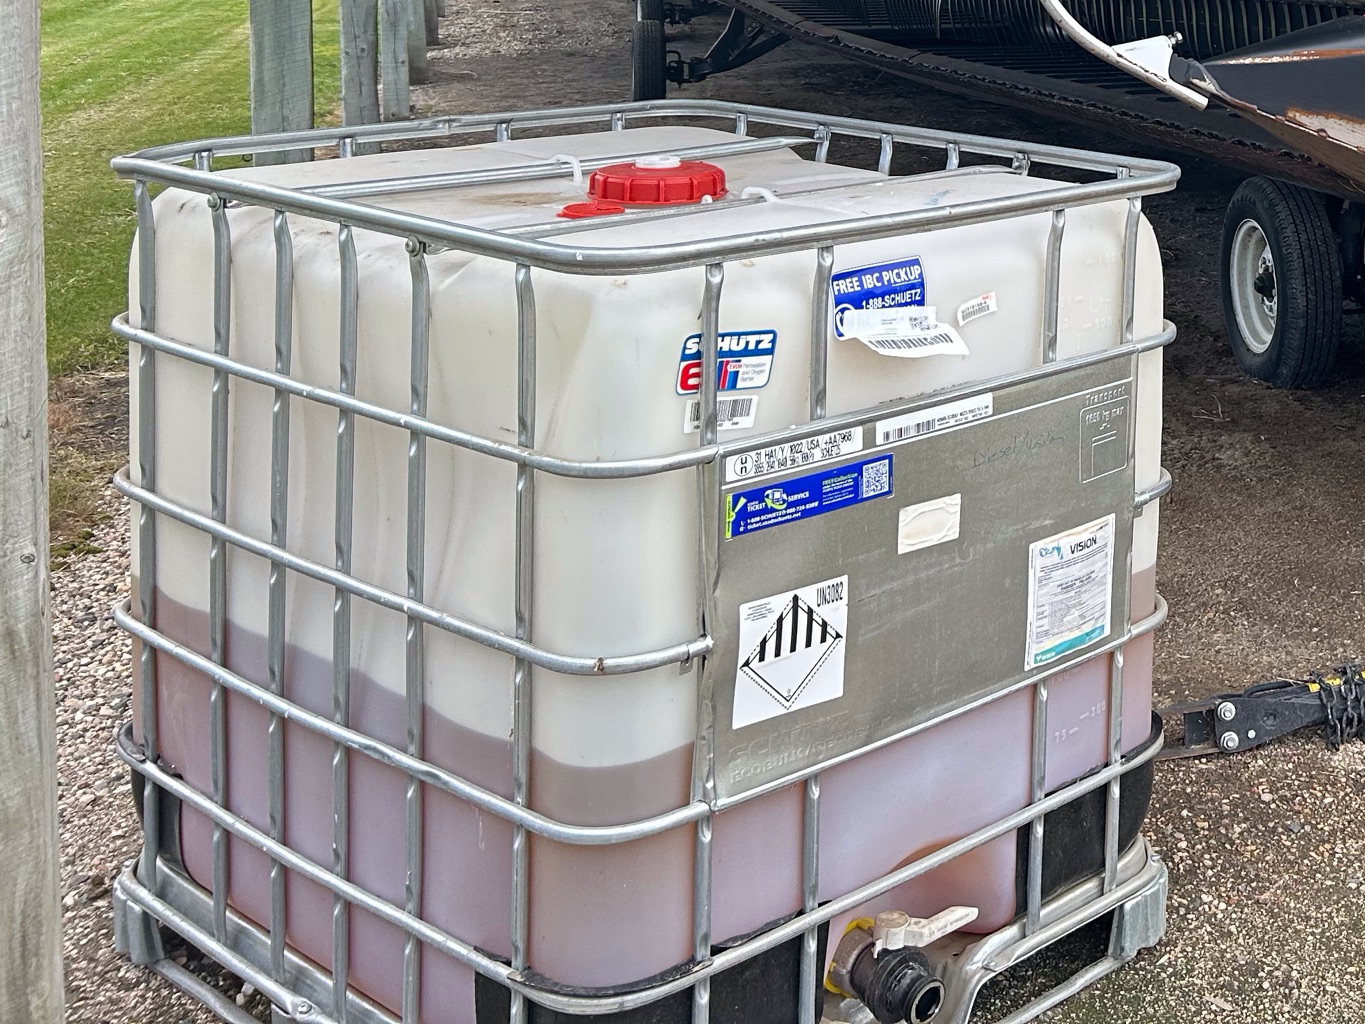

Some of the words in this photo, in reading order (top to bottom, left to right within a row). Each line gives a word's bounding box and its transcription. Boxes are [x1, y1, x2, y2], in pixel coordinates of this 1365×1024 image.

[832, 276, 861, 296] FREE
[862, 272, 882, 289] IBC
[884, 265, 922, 286] PICKUP
[861, 289, 922, 310] 1-888-SCHUETZ
[685, 333, 774, 355] SHÜTZ
[747, 502, 766, 513] TICKET
[787, 491, 810, 502] SERVICE
[816, 581, 844, 608] UN3082
